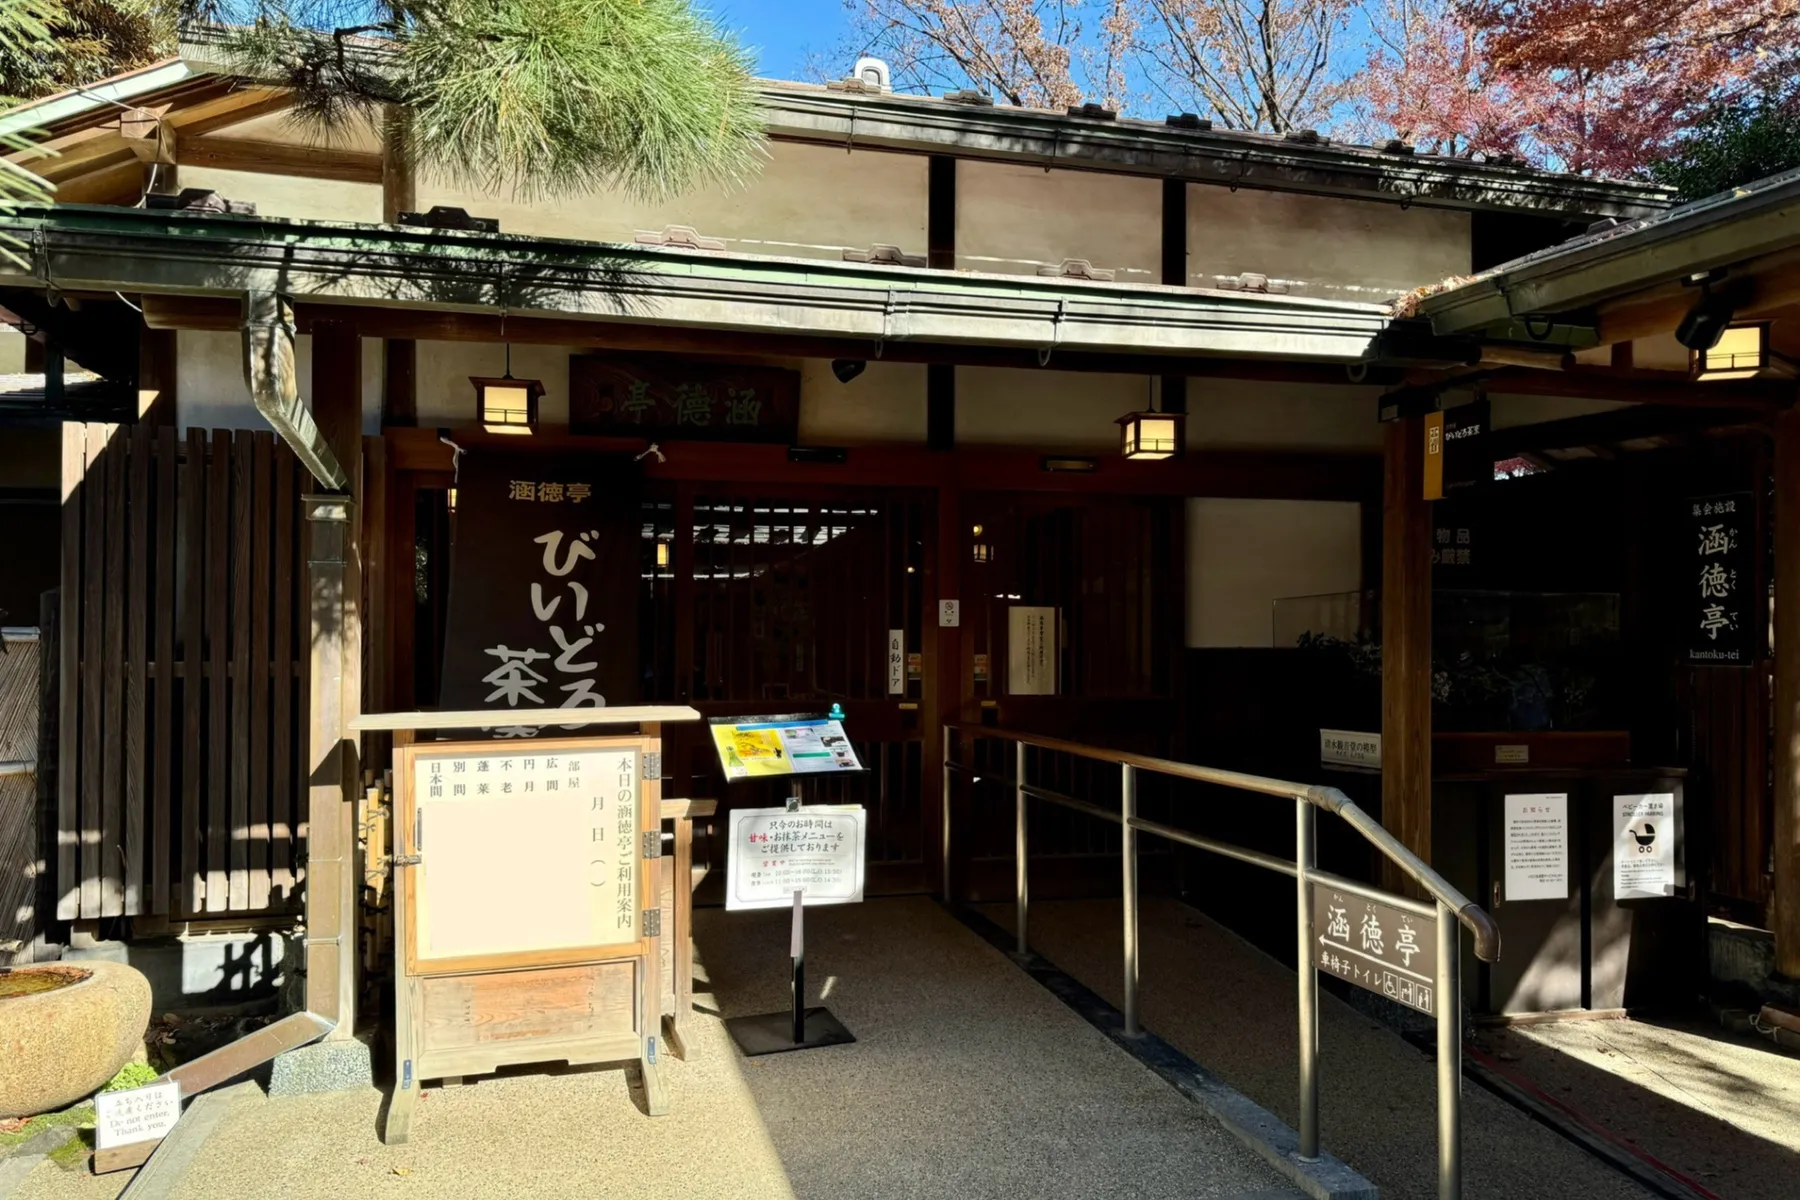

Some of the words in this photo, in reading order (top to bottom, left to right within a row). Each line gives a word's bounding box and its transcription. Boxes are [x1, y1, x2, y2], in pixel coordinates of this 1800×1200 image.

[508, 479, 593, 504] 涵徳亭
[1691, 500, 1737, 517] 集会施設
[1697, 523, 1731, 642] 涵徳亭
[530, 529, 607, 732] びいどろ
[890, 638, 902, 688] 自動ドア
[1689, 648, 1740, 661] kantoku-tei
[481, 644, 553, 740] 茶
[429, 762, 443, 798] 日本間
[452, 760, 467, 797] 別間
[500, 759, 514, 794] 不老
[523, 758, 536, 793] 円月
[546, 757, 560, 791] 広間
[567, 760, 581, 789] 部屋
[591, 796, 605, 811] 月
[592, 827, 605, 843] 日
[769, 818, 833, 830] 只今のお時間は
[616, 757, 633, 929] 本日の涵徳亭ご利用案内
[760, 842, 840, 854] ご提供しております
[1326, 904, 1421, 968] 涵徳亭
[1320, 950, 1382, 987] 車椅子トイレ
[114, 1124, 144, 1136] Thank
[126, 1115, 141, 1125] not
[143, 1110, 170, 1121] enter.
